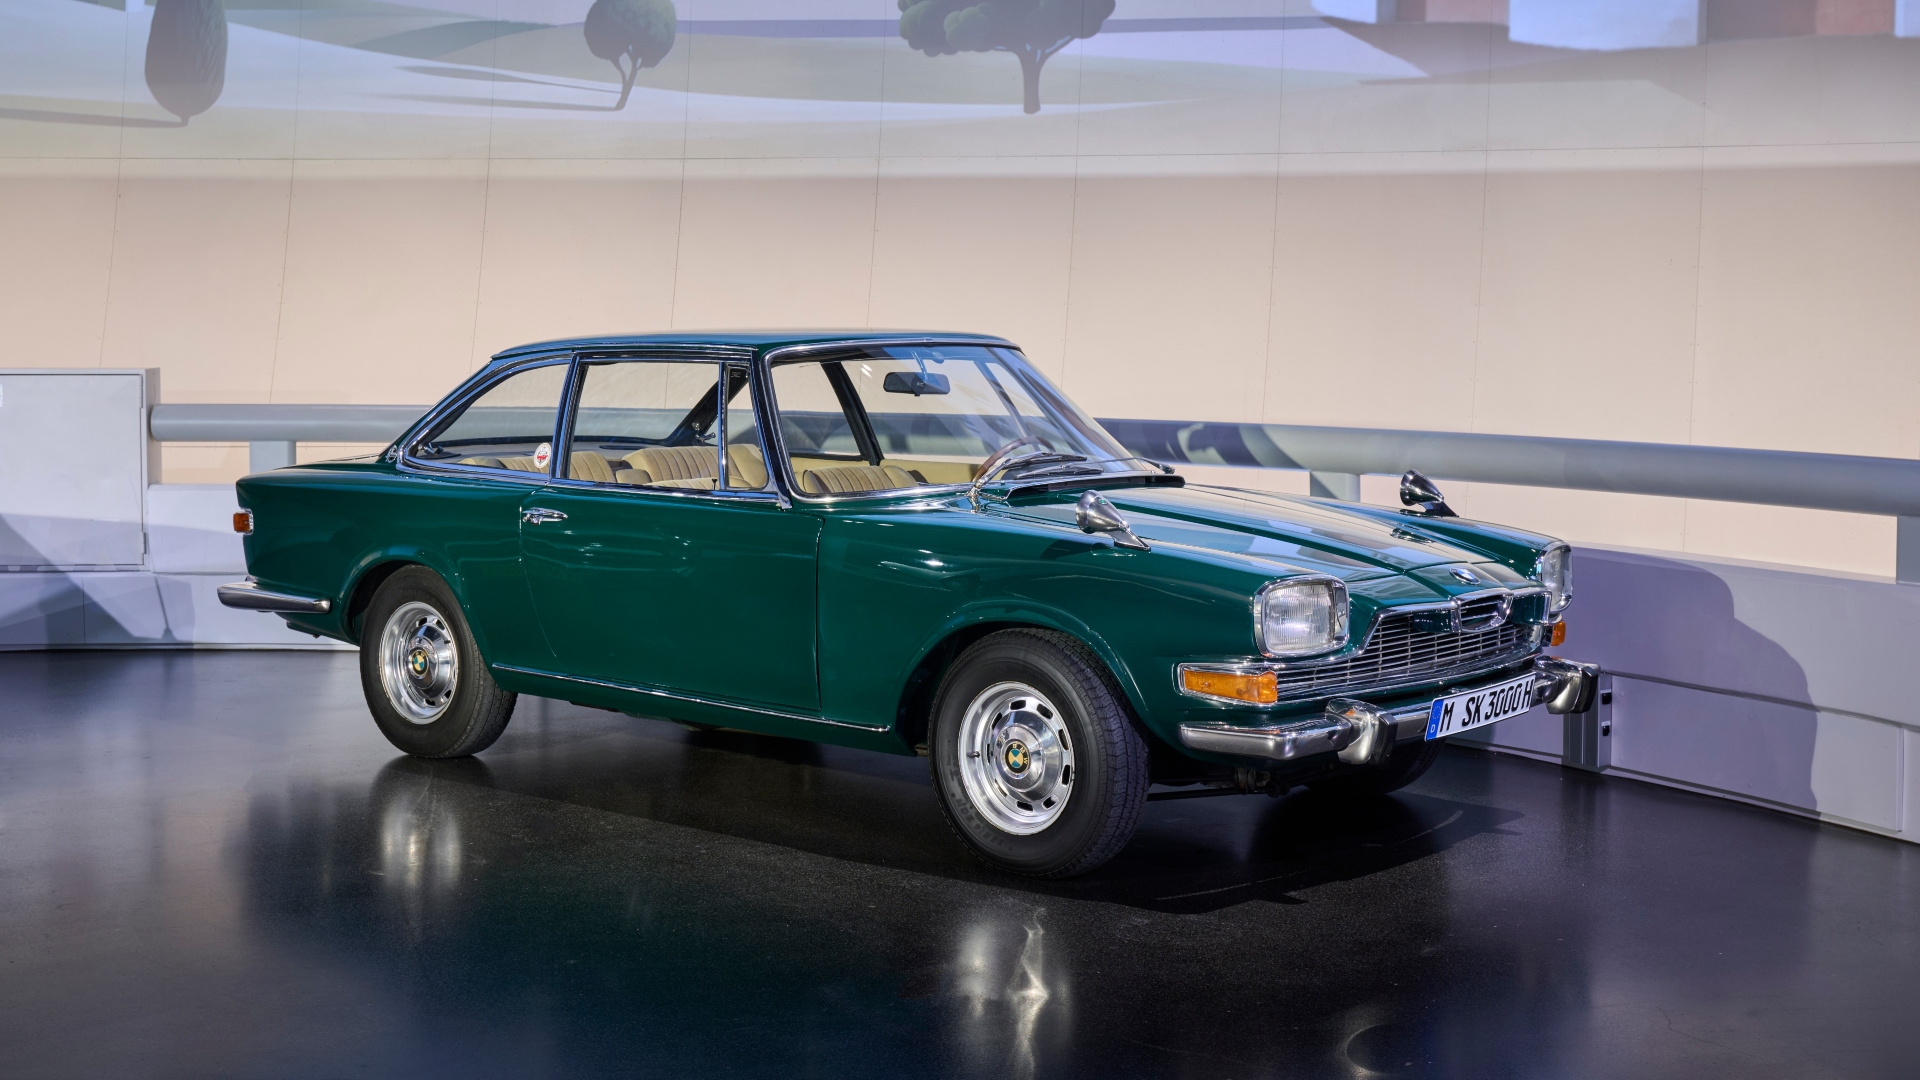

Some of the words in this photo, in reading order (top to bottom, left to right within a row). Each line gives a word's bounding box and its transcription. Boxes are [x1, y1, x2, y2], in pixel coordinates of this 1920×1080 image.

[1440, 701, 1455, 732] M
[1461, 693, 1486, 727] SK
[1430, 724, 1435, 733] D
